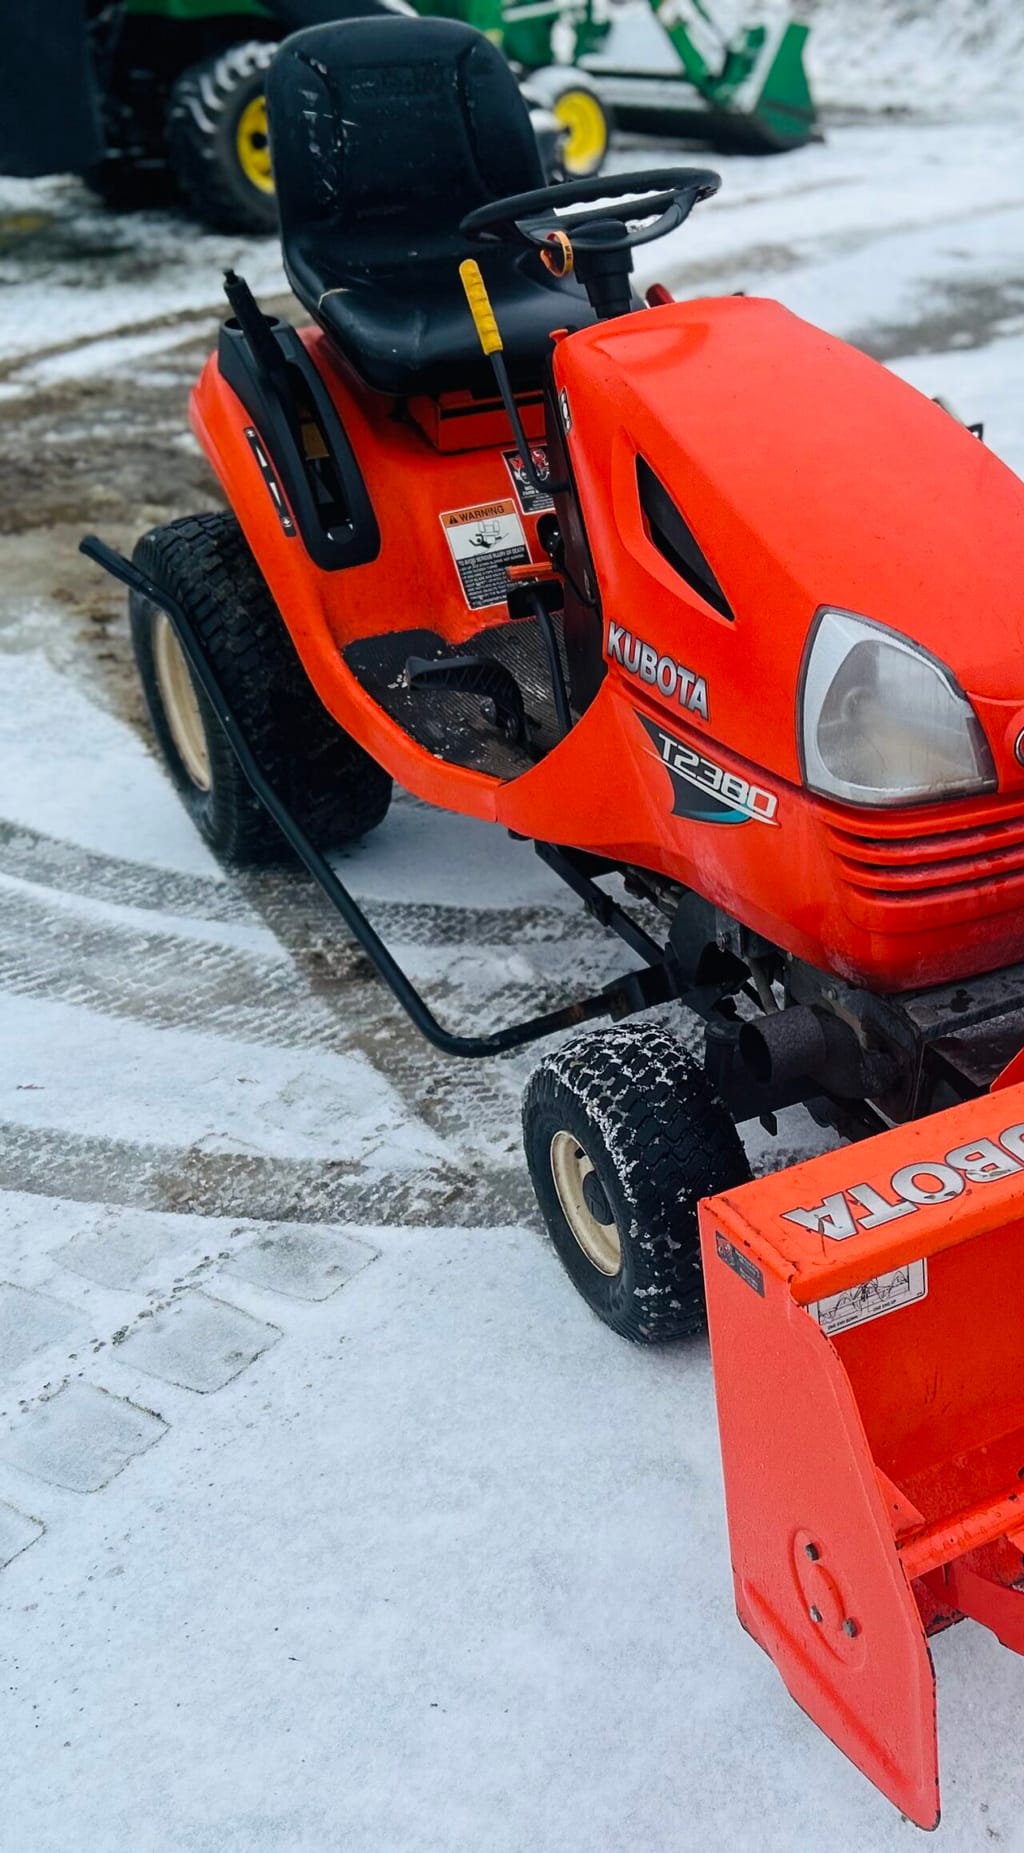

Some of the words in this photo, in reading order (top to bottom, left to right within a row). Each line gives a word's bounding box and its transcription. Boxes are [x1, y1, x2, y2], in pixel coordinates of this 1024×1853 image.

[459, 506, 505, 522] WARNING
[608, 620, 710, 721] KUBOTA
[658, 733, 778, 818] T2380
